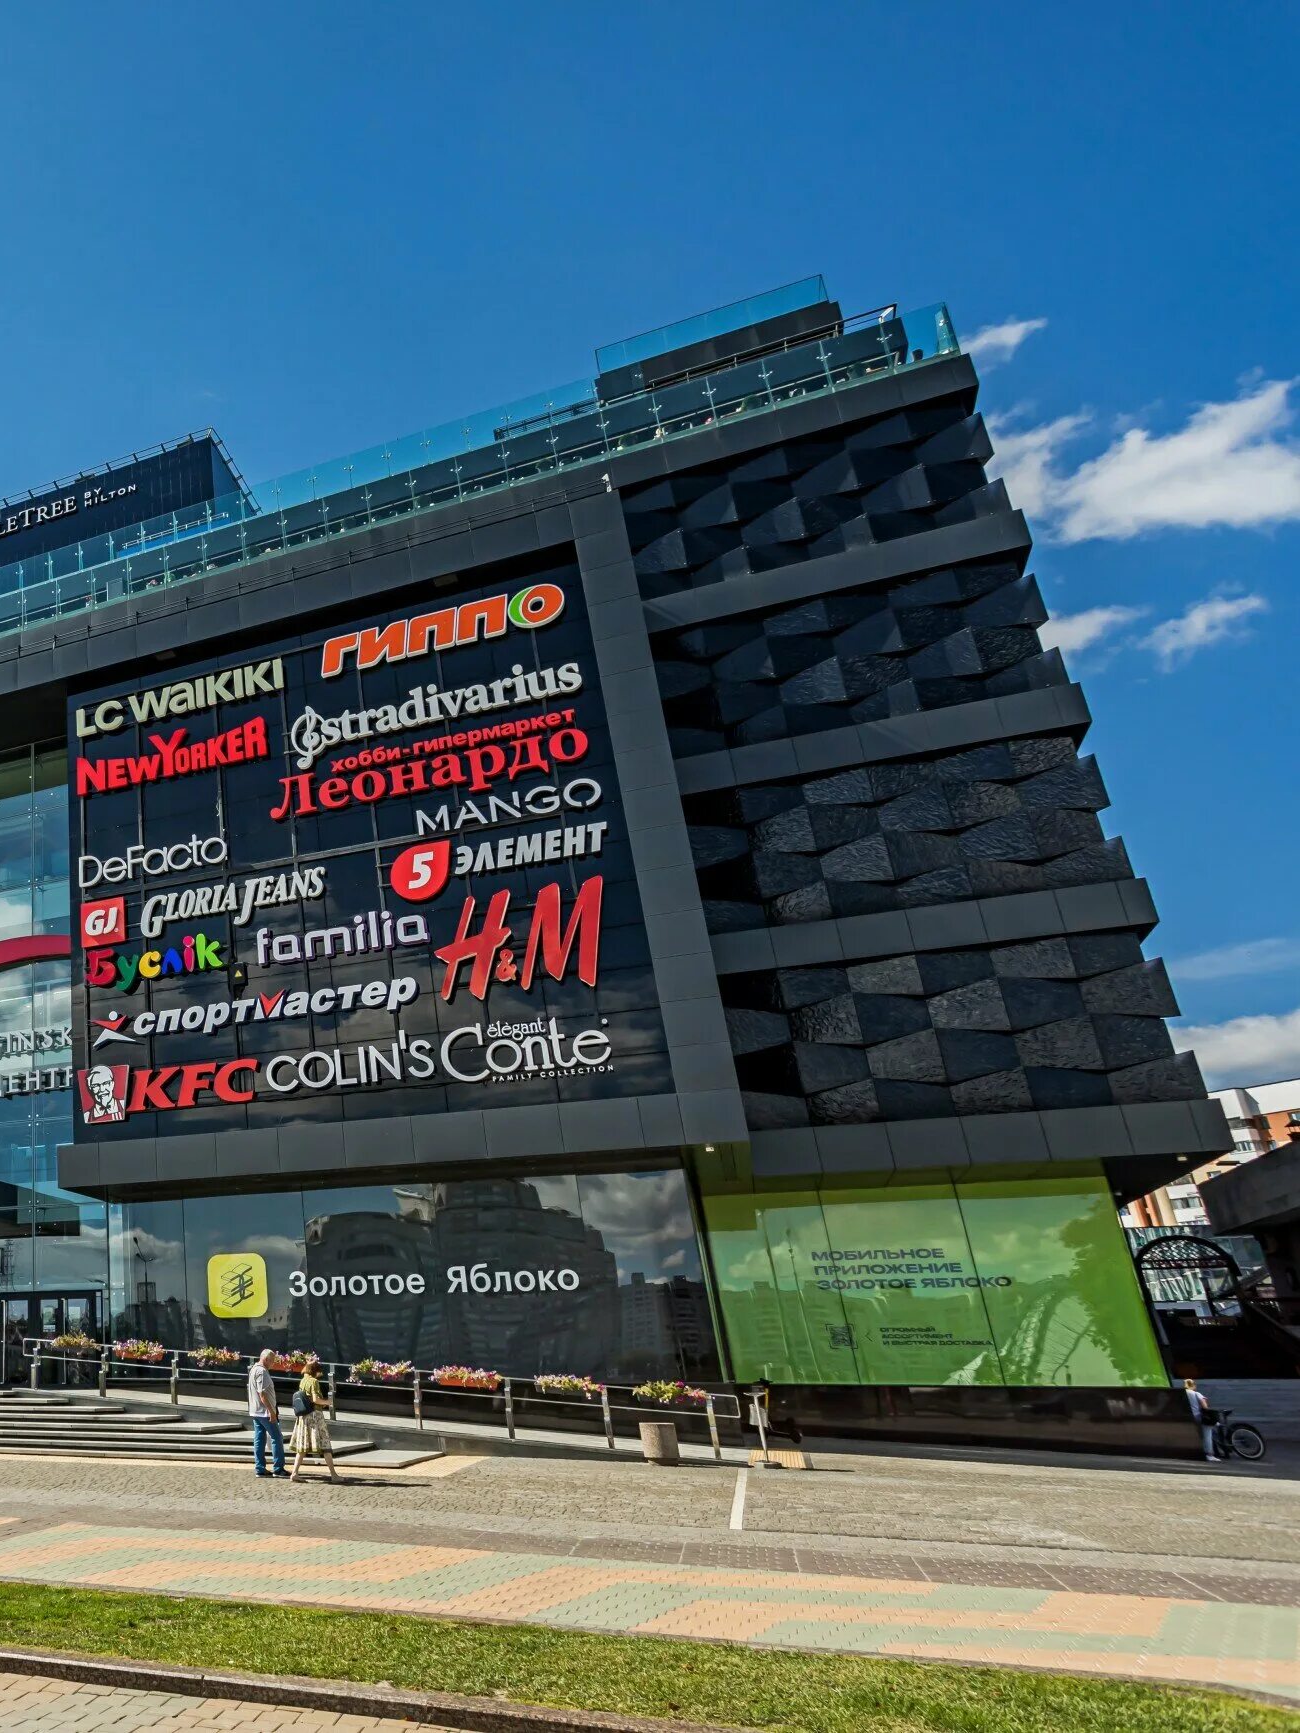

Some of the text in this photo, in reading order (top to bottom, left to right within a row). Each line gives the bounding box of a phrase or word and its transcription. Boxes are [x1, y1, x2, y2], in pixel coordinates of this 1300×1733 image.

[84, 487, 102, 499] BY
[84, 484, 137, 507] HILTON
[76, 700, 124, 738] LC
[331, 709, 576, 773] хобби-гипермаркет
[270, 728, 588, 821] Леонардо
[415, 778, 602, 836] MANGO
[79, 834, 228, 888] DeFacto
[408, 821, 608, 890] 5 ЭЛЕМЕНТ
[85, 906, 118, 936] GJ
[140, 866, 326, 938] GLORIA JEANS
[256, 910, 430, 967] familia
[434, 875, 604, 1000] H&M
[266, 1029, 435, 1093] COLIN'S
[441, 1016, 612, 1082] Conte
[492, 1065, 614, 1082] FAMILY COLLECTION
[126, 1058, 259, 1113] KFC
[288, 1262, 581, 1298] Золотое Яблоко
[811, 1248, 945, 1262] МОБИЛЬНОЕ
[814, 1262, 963, 1276] ПРИЛОЖЕНИЕ
[818, 1276, 1013, 1290] ЗОЛОТОЕ ЯБЛОКО
